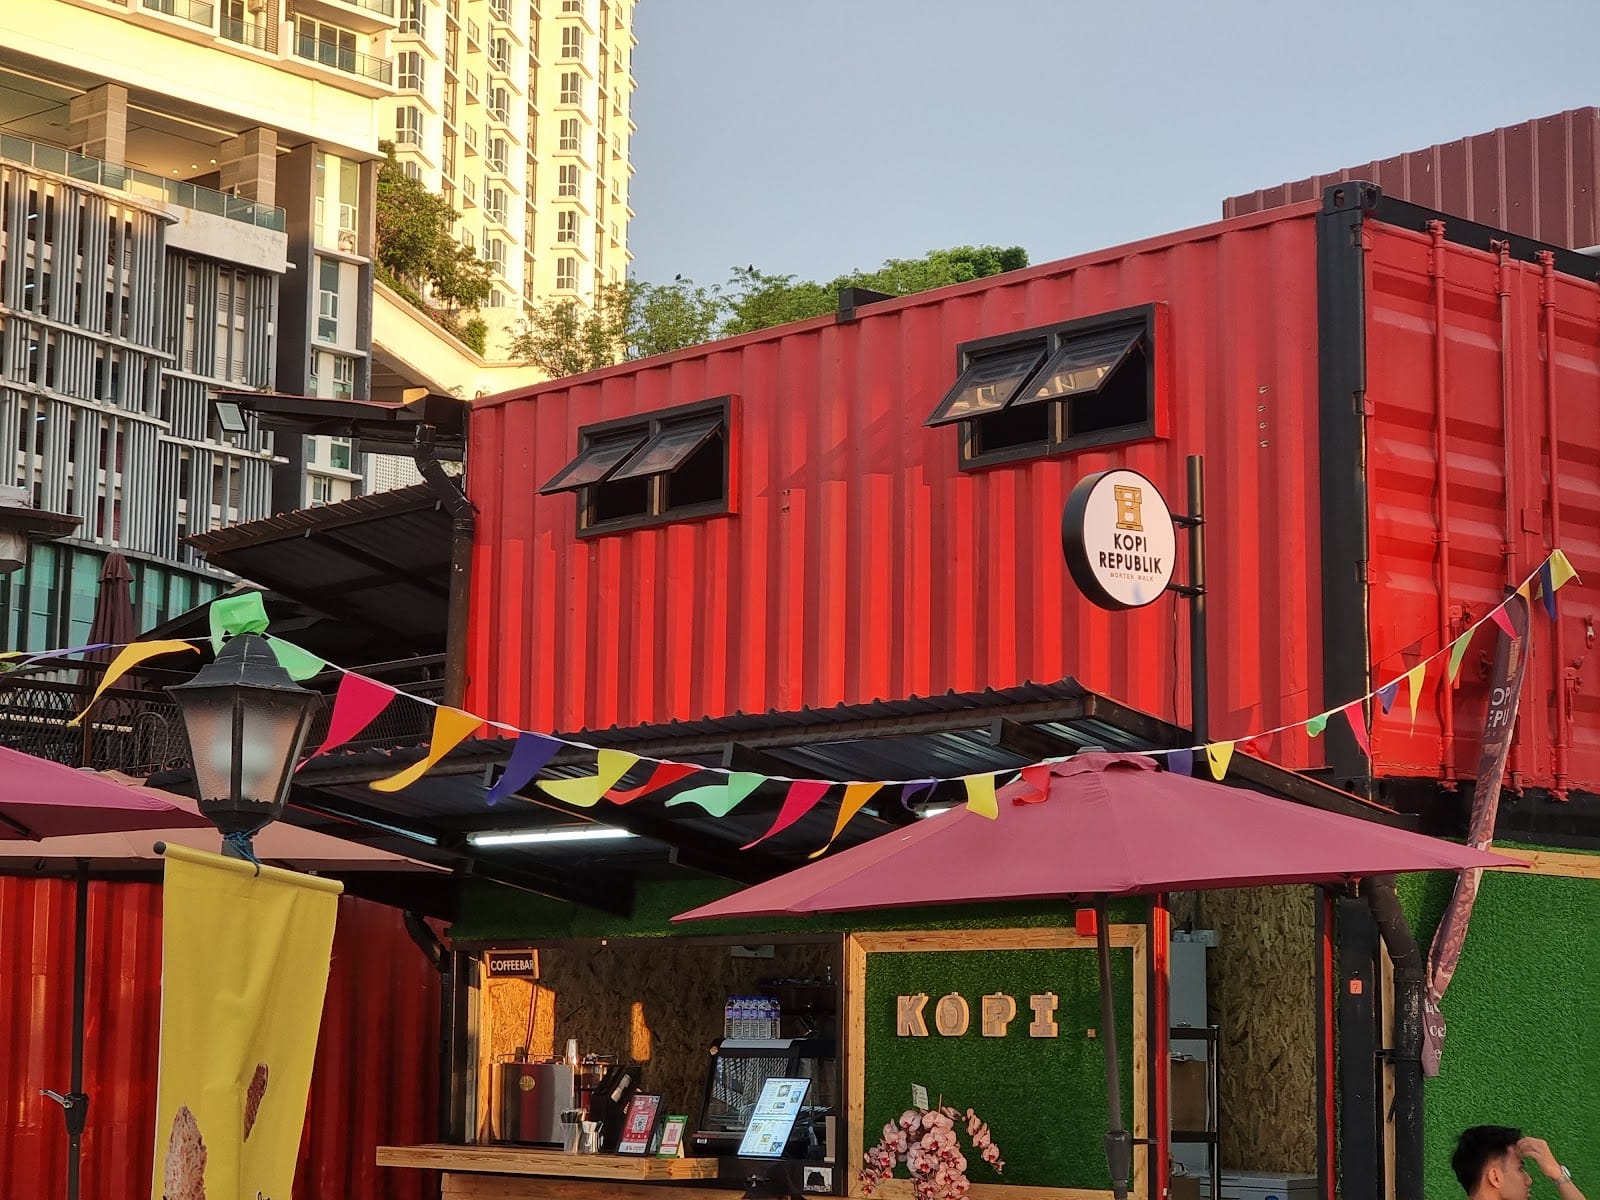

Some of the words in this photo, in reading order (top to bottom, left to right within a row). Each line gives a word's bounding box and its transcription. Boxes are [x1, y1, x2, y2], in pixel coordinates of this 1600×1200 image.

[1113, 533, 1147, 553] KOPI
[1099, 551, 1162, 574] REPUBLIK
[1492, 687, 1512, 706] OPI
[490, 959, 534, 972] COFFEEBAR
[896, 993, 1059, 1038] KOPI
